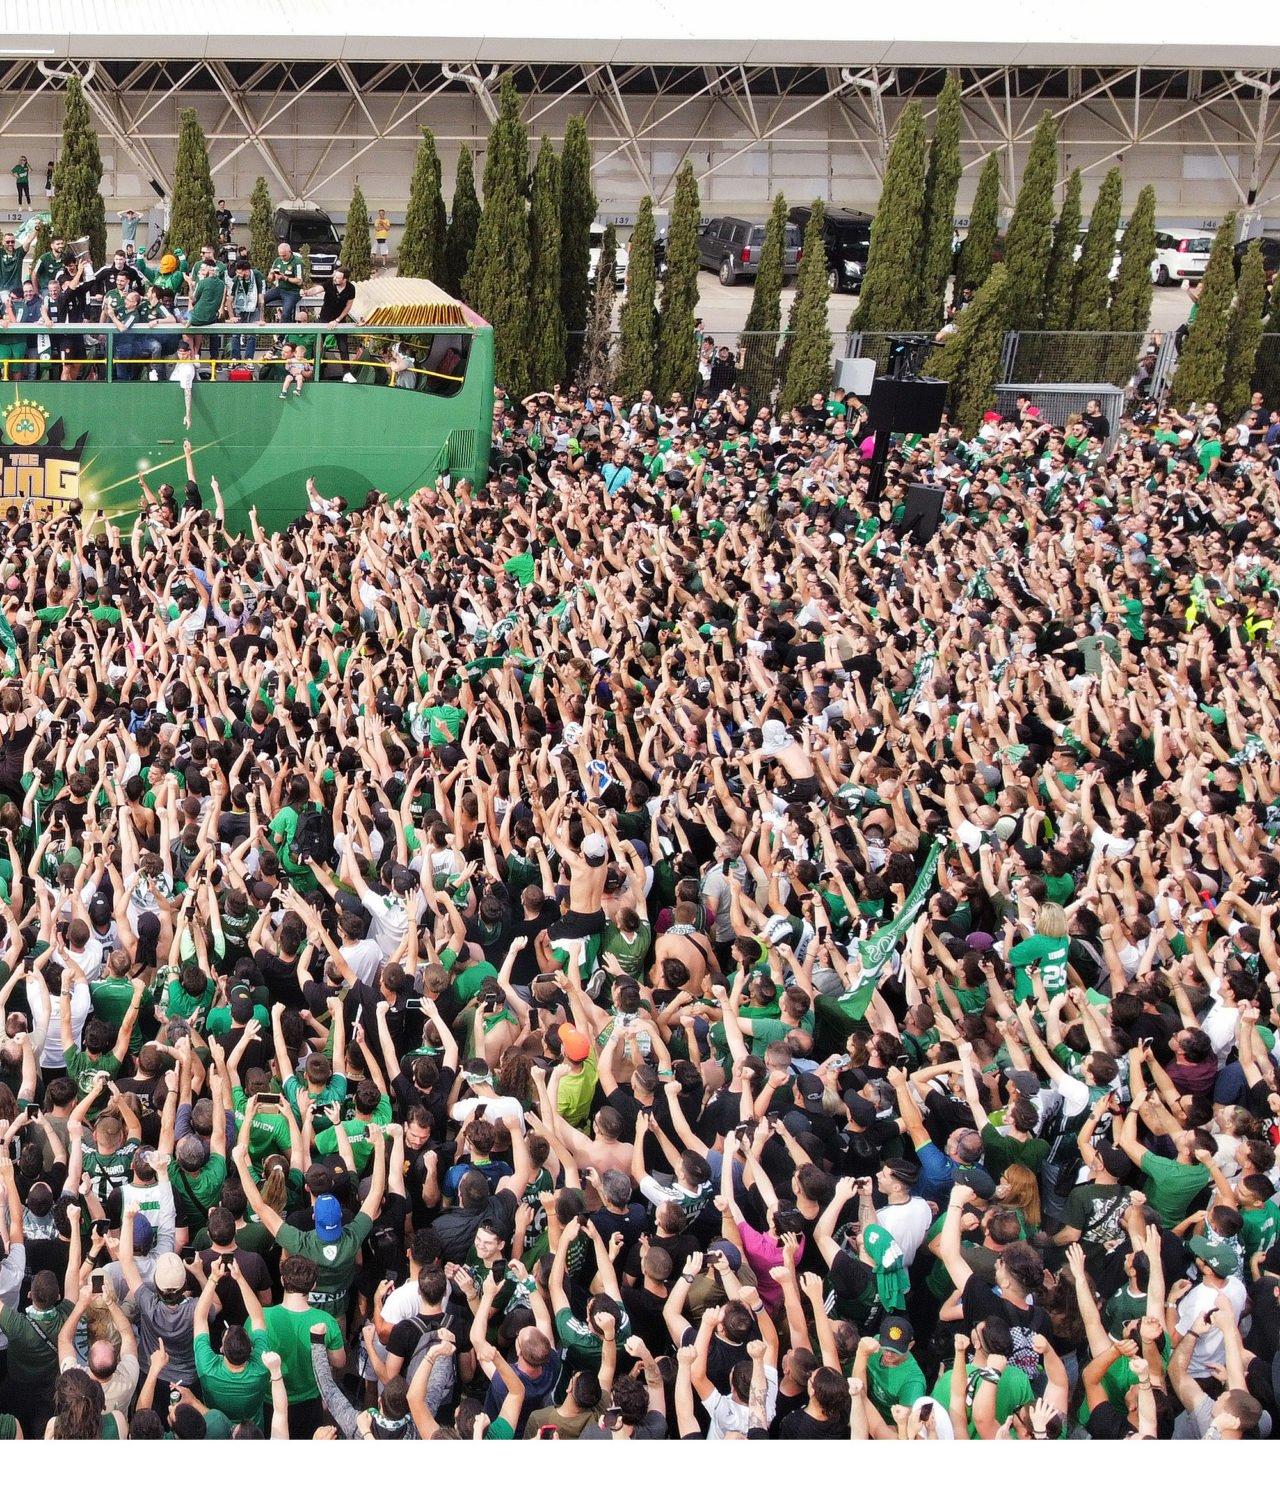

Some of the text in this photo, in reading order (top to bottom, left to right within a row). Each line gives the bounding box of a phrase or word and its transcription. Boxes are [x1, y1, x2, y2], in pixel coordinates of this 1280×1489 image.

[615, 216, 630, 224] 139
[9, 453, 40, 466] THE
[1043, 961, 1067, 988] 25
